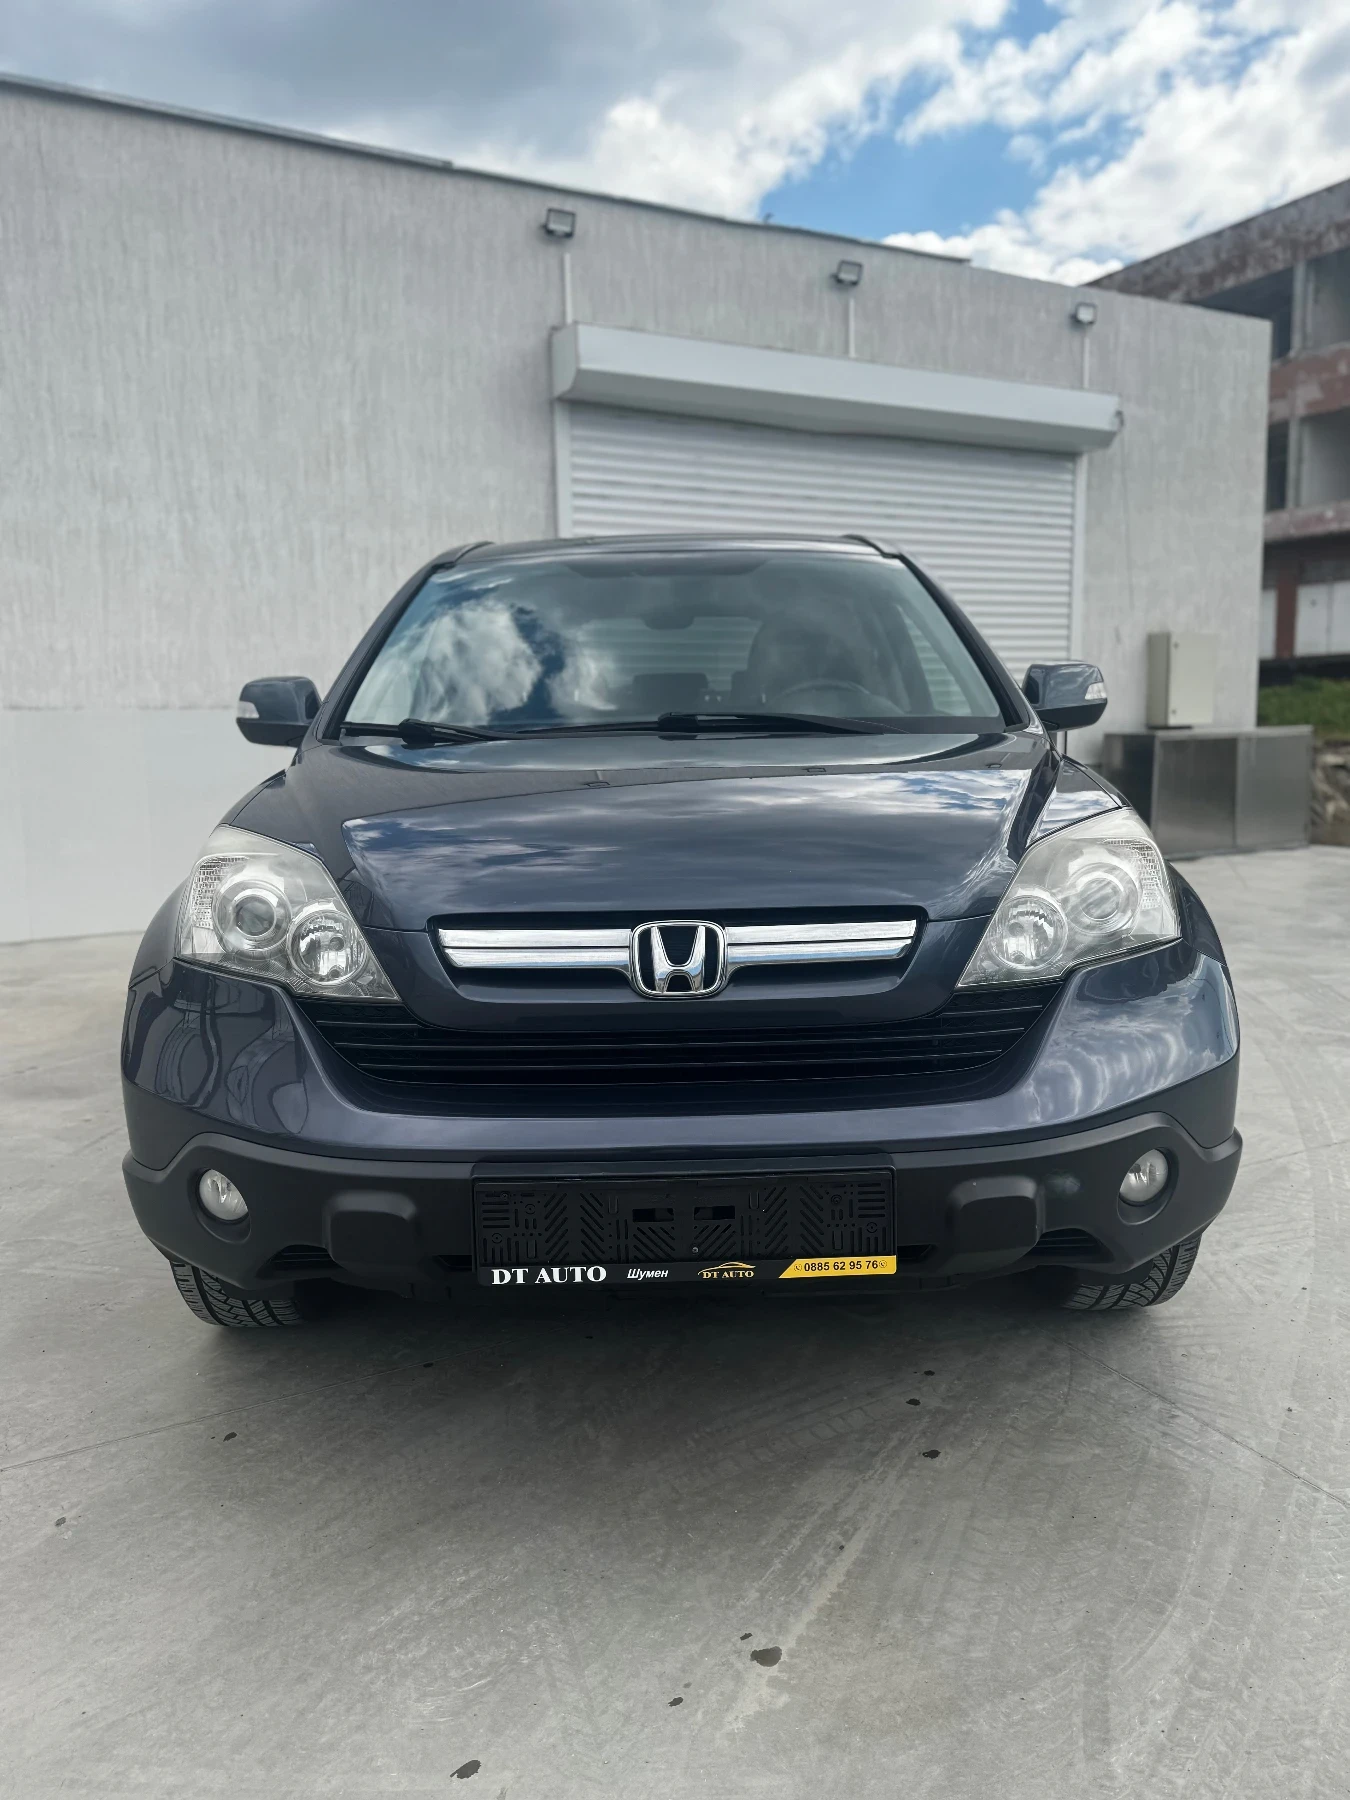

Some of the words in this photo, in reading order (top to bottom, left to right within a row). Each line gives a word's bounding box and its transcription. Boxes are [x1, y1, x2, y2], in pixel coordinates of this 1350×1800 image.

[804, 1262, 830, 1272] 0885
[833, 1261, 846, 1271] 62
[849, 1260, 862, 1270] 95
[865, 1259, 878, 1270] 76
[491, 1269, 528, 1285] DT
[534, 1266, 607, 1284] AUTO
[626, 1268, 669, 1281] Шумен
[702, 1271, 718, 1279] DT
[721, 1270, 755, 1278] AUTO
